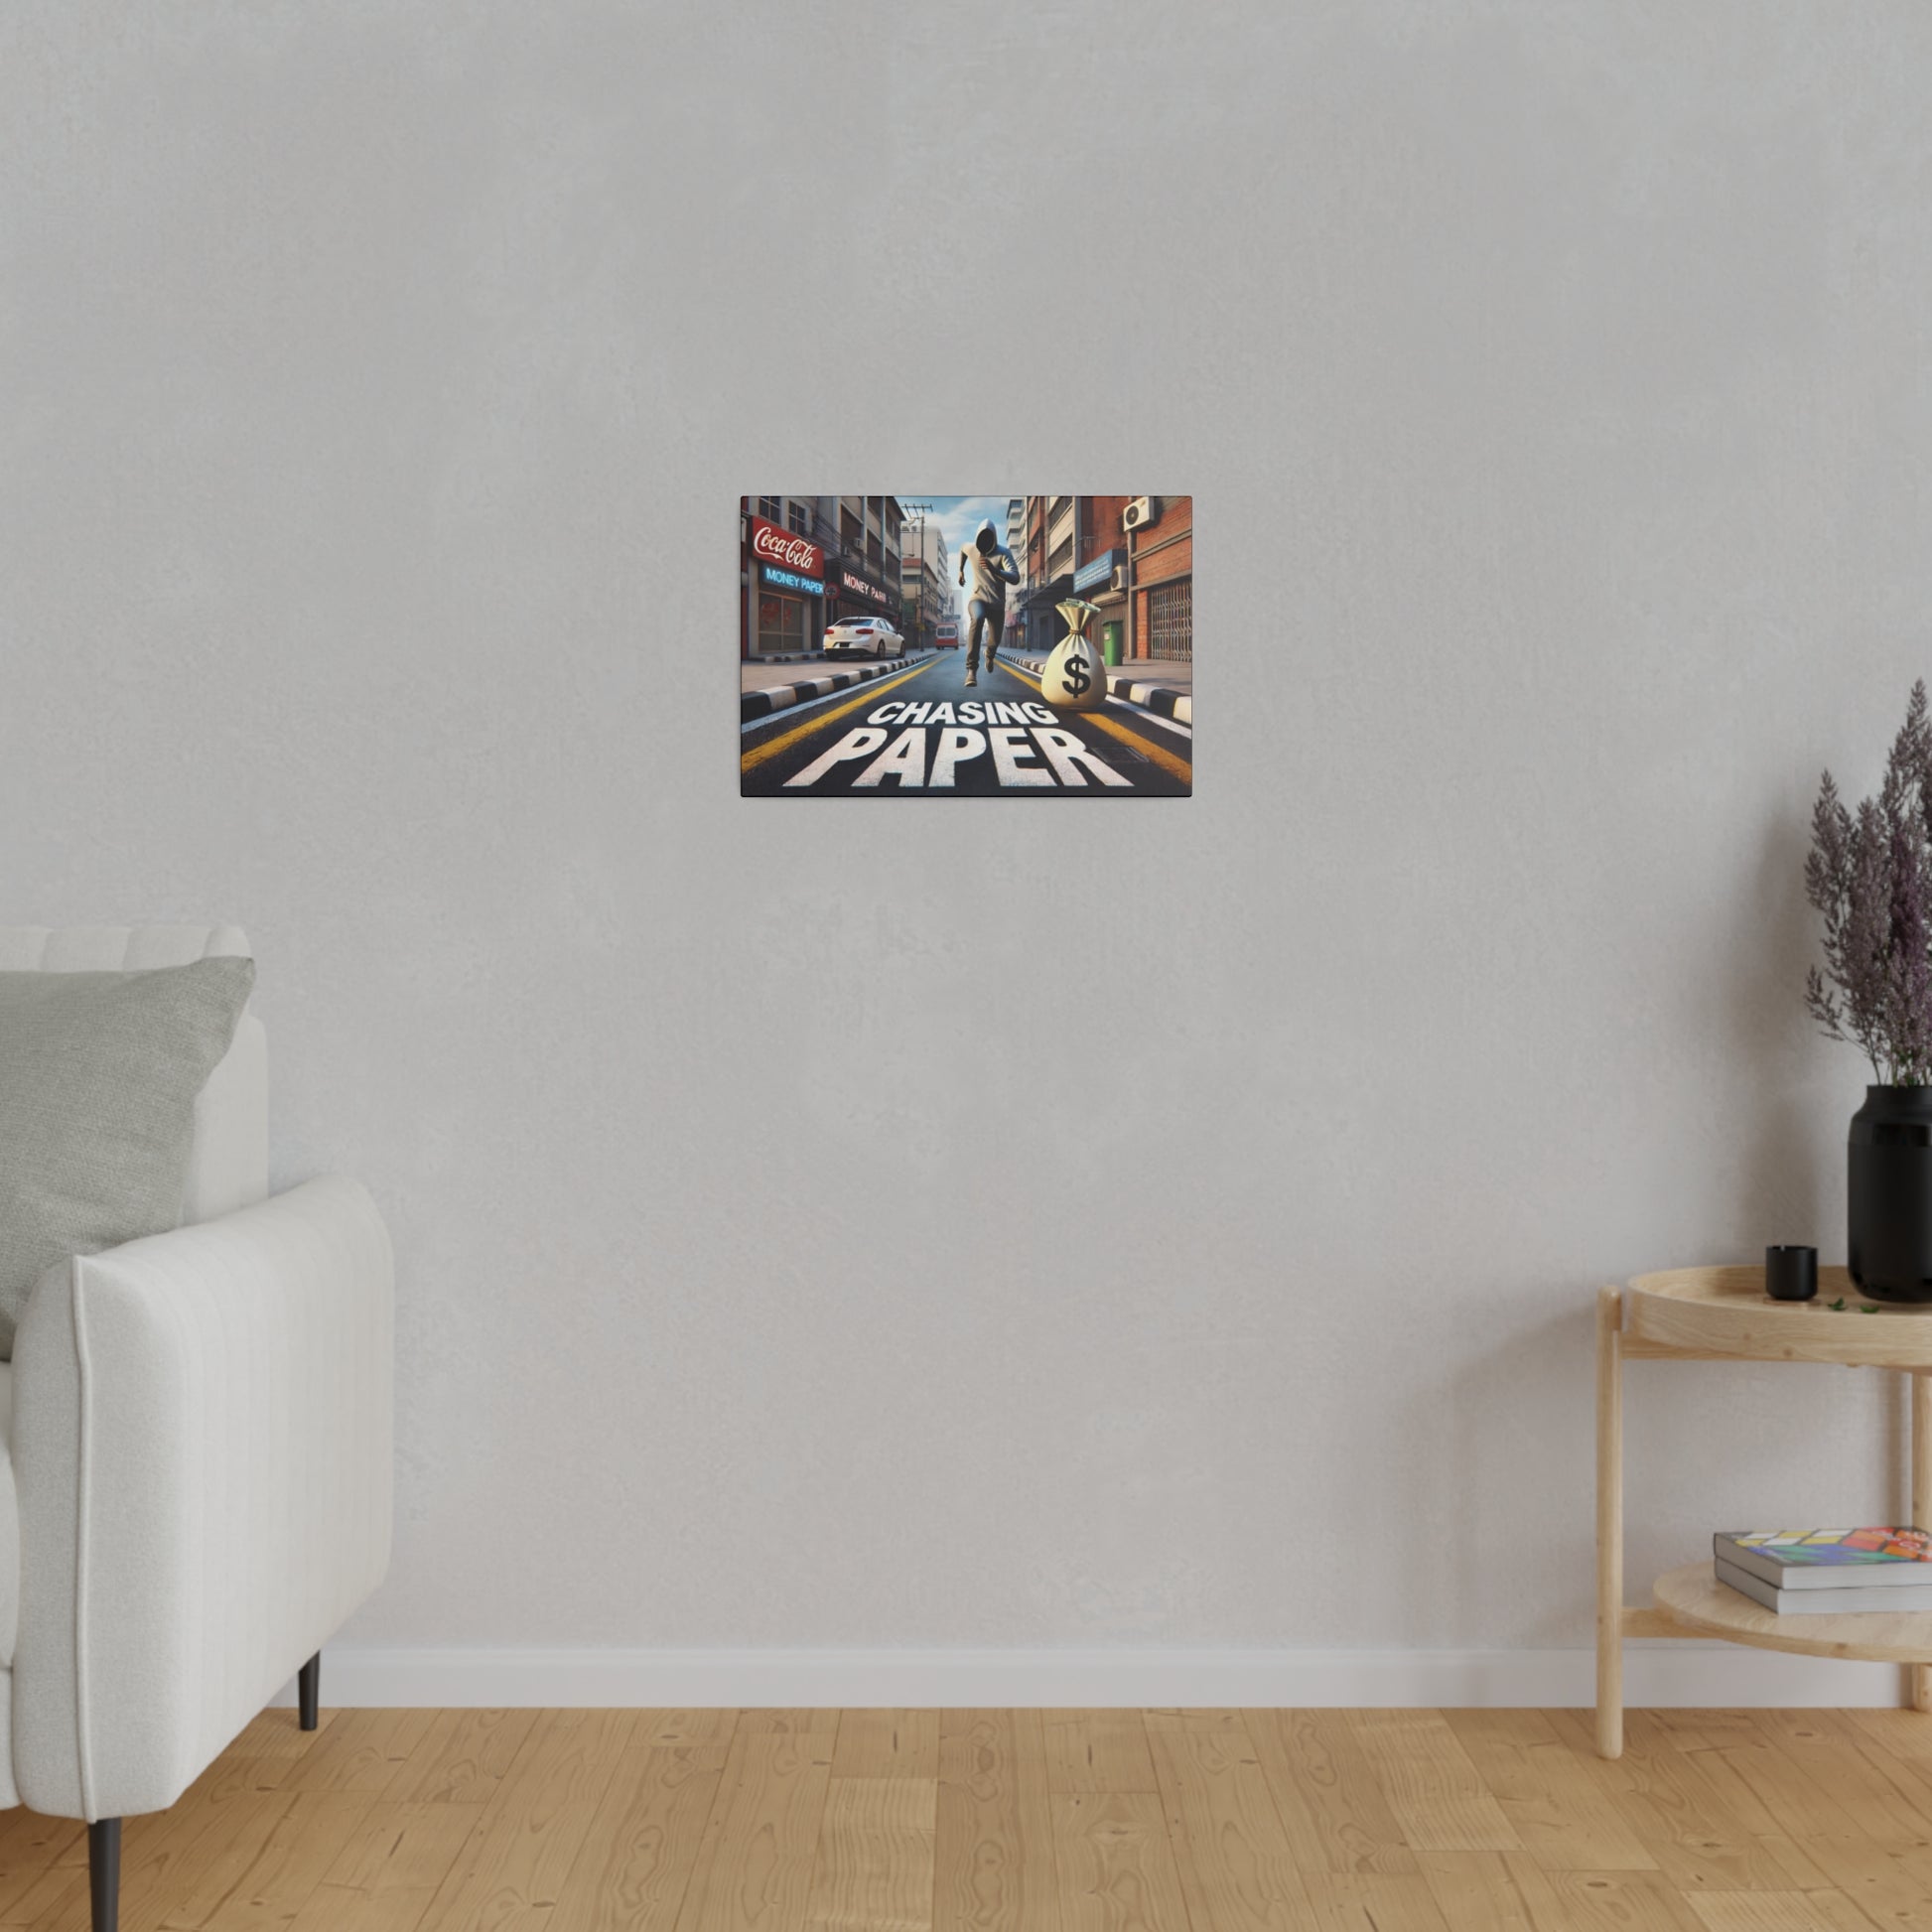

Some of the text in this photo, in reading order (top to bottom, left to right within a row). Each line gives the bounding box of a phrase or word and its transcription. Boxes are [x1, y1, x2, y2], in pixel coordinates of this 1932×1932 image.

[754, 526, 816, 569] Coca-Cola
[765, 567, 799, 588] MONEY
[843, 572, 869, 596] MONEY
[867, 701, 1059, 725] CHASING
[781, 727, 1135, 787] PAPER
